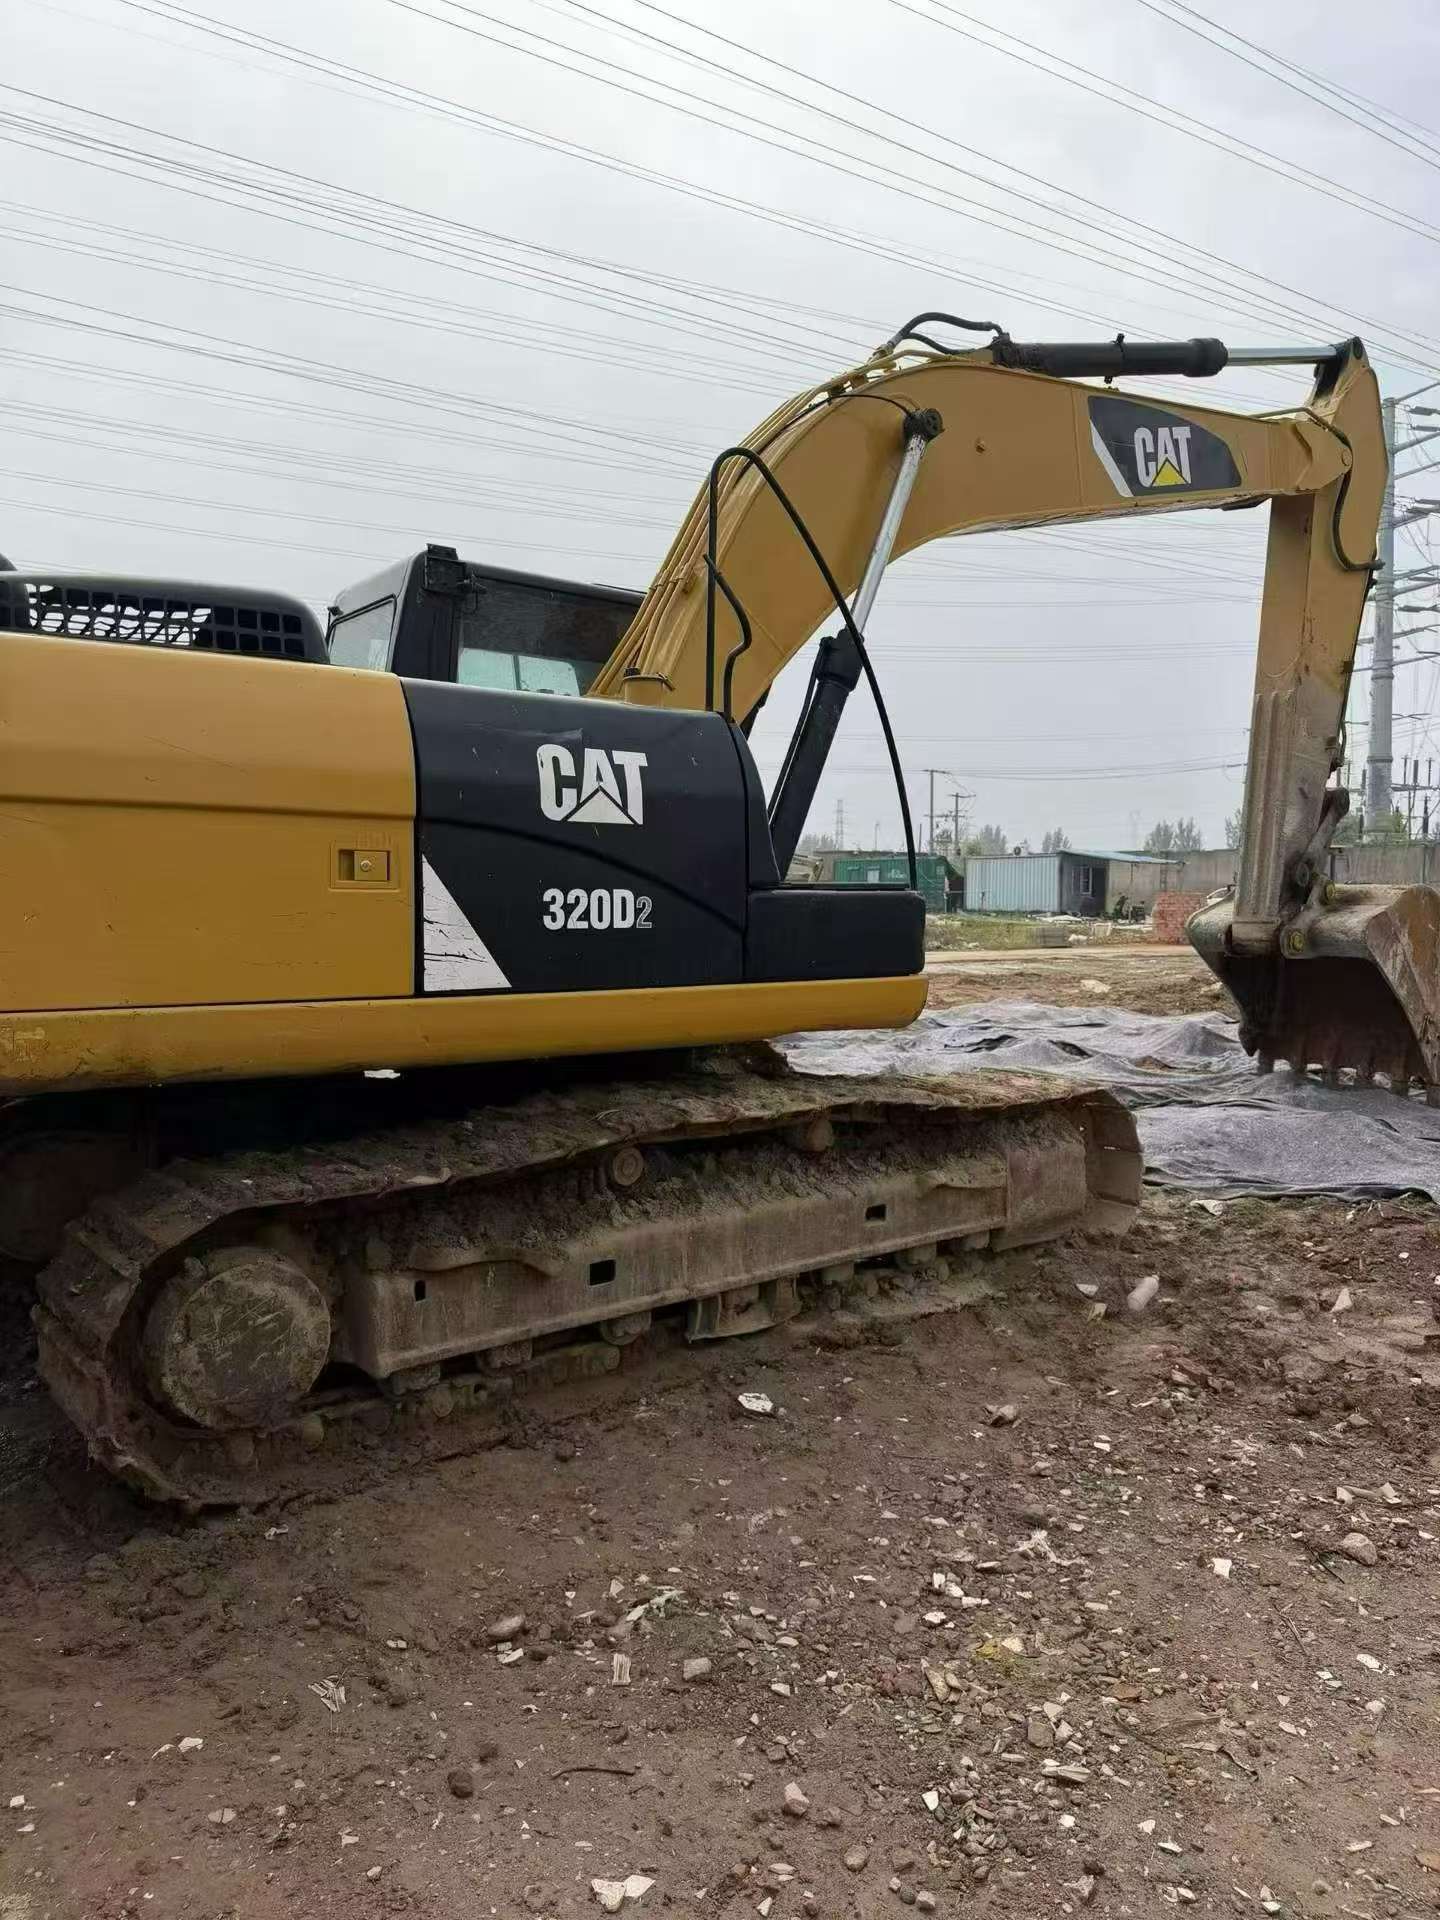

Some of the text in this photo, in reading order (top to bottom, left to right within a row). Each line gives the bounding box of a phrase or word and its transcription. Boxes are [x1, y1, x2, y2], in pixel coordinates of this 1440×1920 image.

[1134, 426, 1192, 488] CAT
[536, 743, 648, 825] CAT
[542, 887, 653, 931] 320D2
